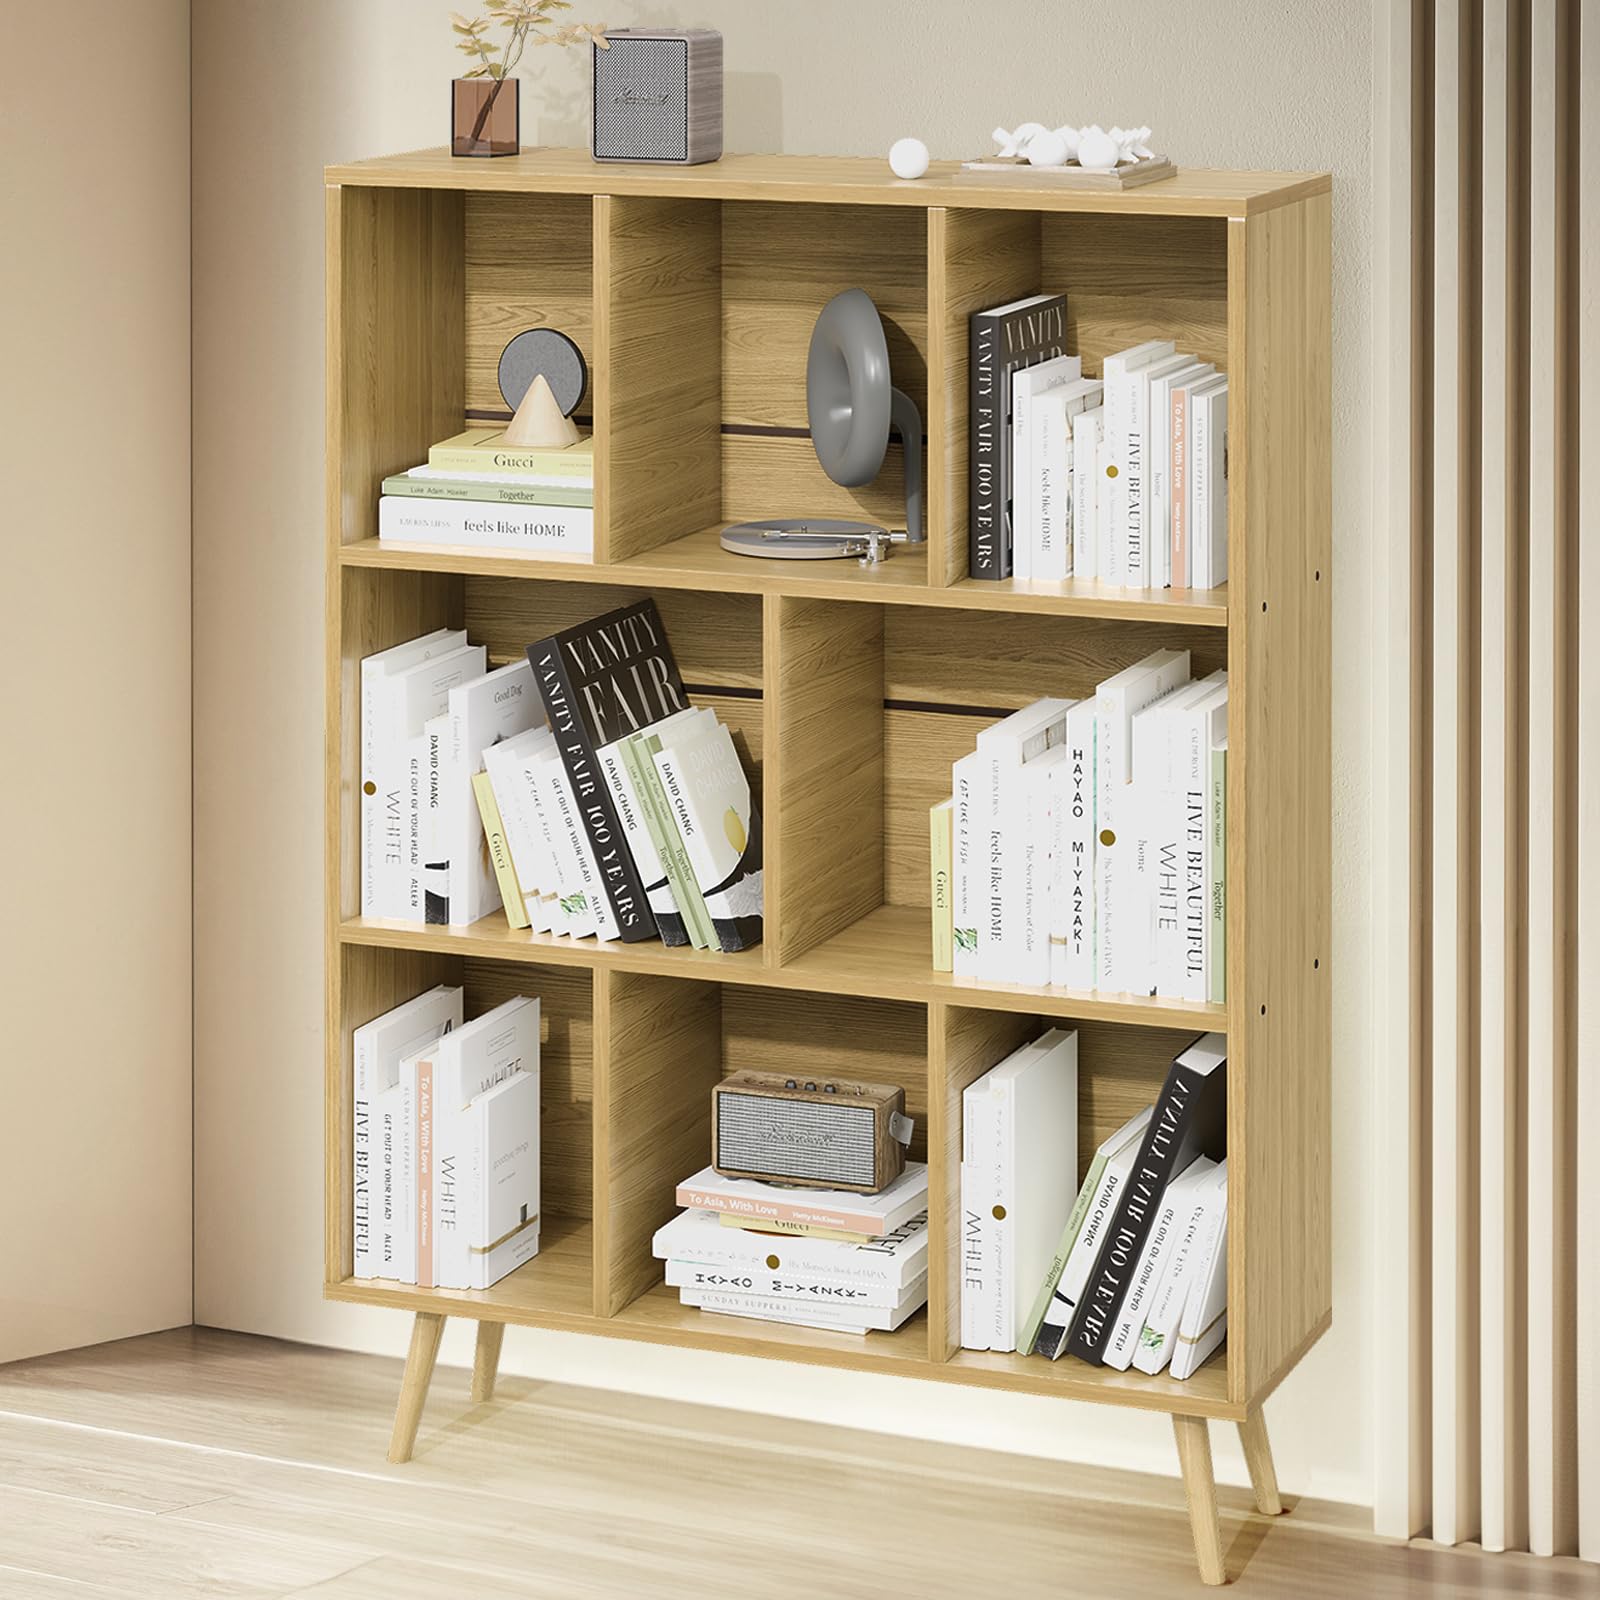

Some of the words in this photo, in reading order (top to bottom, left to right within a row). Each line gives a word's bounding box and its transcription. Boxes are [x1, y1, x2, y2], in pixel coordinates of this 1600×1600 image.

[1004, 303, 1065, 353] VANITY
[978, 327, 993, 399] VANITY
[978, 408, 993, 454] FAIR
[493, 452, 535, 469] Gucci
[1127, 433, 1141, 471] LIVE
[1175, 441, 1183, 465] With
[498, 489, 536, 501] Together
[977, 463, 993, 496] 100
[1041, 468, 1051, 493] feels
[1041, 495, 1051, 515] like
[464, 519, 494, 533] feels
[497, 520, 521, 535] like
[523, 523, 566, 537] HOME
[977, 502, 993, 569] YEARS
[1041, 518, 1051, 552] HOME
[1127, 477, 1141, 574] BEAUTIFUL
[565, 610, 660, 677] VANITY
[494, 688, 511, 704] Good
[511, 684, 523, 700] Dog
[579, 655, 685, 745] FAIR
[410, 758, 418, 775] GET
[430, 735, 439, 769] DAVID
[410, 778, 418, 796] OUT
[430, 770, 439, 808] CHANG
[538, 653, 577, 735] VANITY
[567, 743, 596, 798] FAIR
[586, 804, 612, 844] 100
[602, 848, 640, 928] YEARS
[551, 777, 563, 794] GET
[604, 757, 622, 793] DAVID
[617, 793, 638, 831] CHANG
[1072, 749, 1084, 818] HAYAO
[410, 799, 418, 809] OF
[558, 796, 570, 815] OUT
[661, 762, 681, 797] DAVID
[674, 797, 695, 837] CHANG
[385, 790, 401, 865] WHITE
[410, 813, 418, 838] YOUR
[565, 816, 575, 829] OF
[1187, 791, 1203, 841] LIVE
[410, 839, 418, 865] HEAD
[491, 832, 509, 869] Gucci
[569, 830, 584, 855] YOUR
[991, 830, 1002, 863] feels
[1138, 839, 1148, 873] home
[577, 855, 592, 883] HEAD
[659, 847, 675, 880] Together
[675, 848, 691, 881] Together
[991, 866, 1002, 892] like
[410, 878, 418, 908] ALLEN
[937, 871, 948, 909] Gucci
[1072, 841, 1084, 954] MIYAZAKI
[1159, 842, 1178, 931] WHITE
[1213, 880, 1224, 921] Together
[590, 895, 606, 924] ALLEN
[991, 896, 1002, 941] HOME
[1186, 851, 1203, 978] BEAUTIFUL
[421, 1076, 430, 1090] To
[480, 1057, 523, 1093] WHITE
[356, 1100, 369, 1143] LIVE
[384, 1113, 392, 1131] GET
[421, 1120, 430, 1148] With
[384, 1132, 392, 1152] OUT
[384, 1153, 392, 1166] OF
[420, 1150, 430, 1174] Love
[384, 1168, 392, 1194] YOUR
[440, 1156, 456, 1231] WHITE
[356, 1150, 369, 1258] BEAUTIFUL
[384, 1195, 392, 1220] HEAD
[689, 1193, 701, 1204] To
[703, 1196, 727, 1209] Asia,
[729, 1199, 753, 1212] With
[755, 1203, 778, 1216] Love
[384, 1233, 392, 1262] ALLEN
[695, 1272, 753, 1288] HAYAO
[772, 1279, 868, 1298] MIYAZAKI
[860, 1268, 888, 1280] JAPAN
[701, 1294, 739, 1306] SUNDAY
